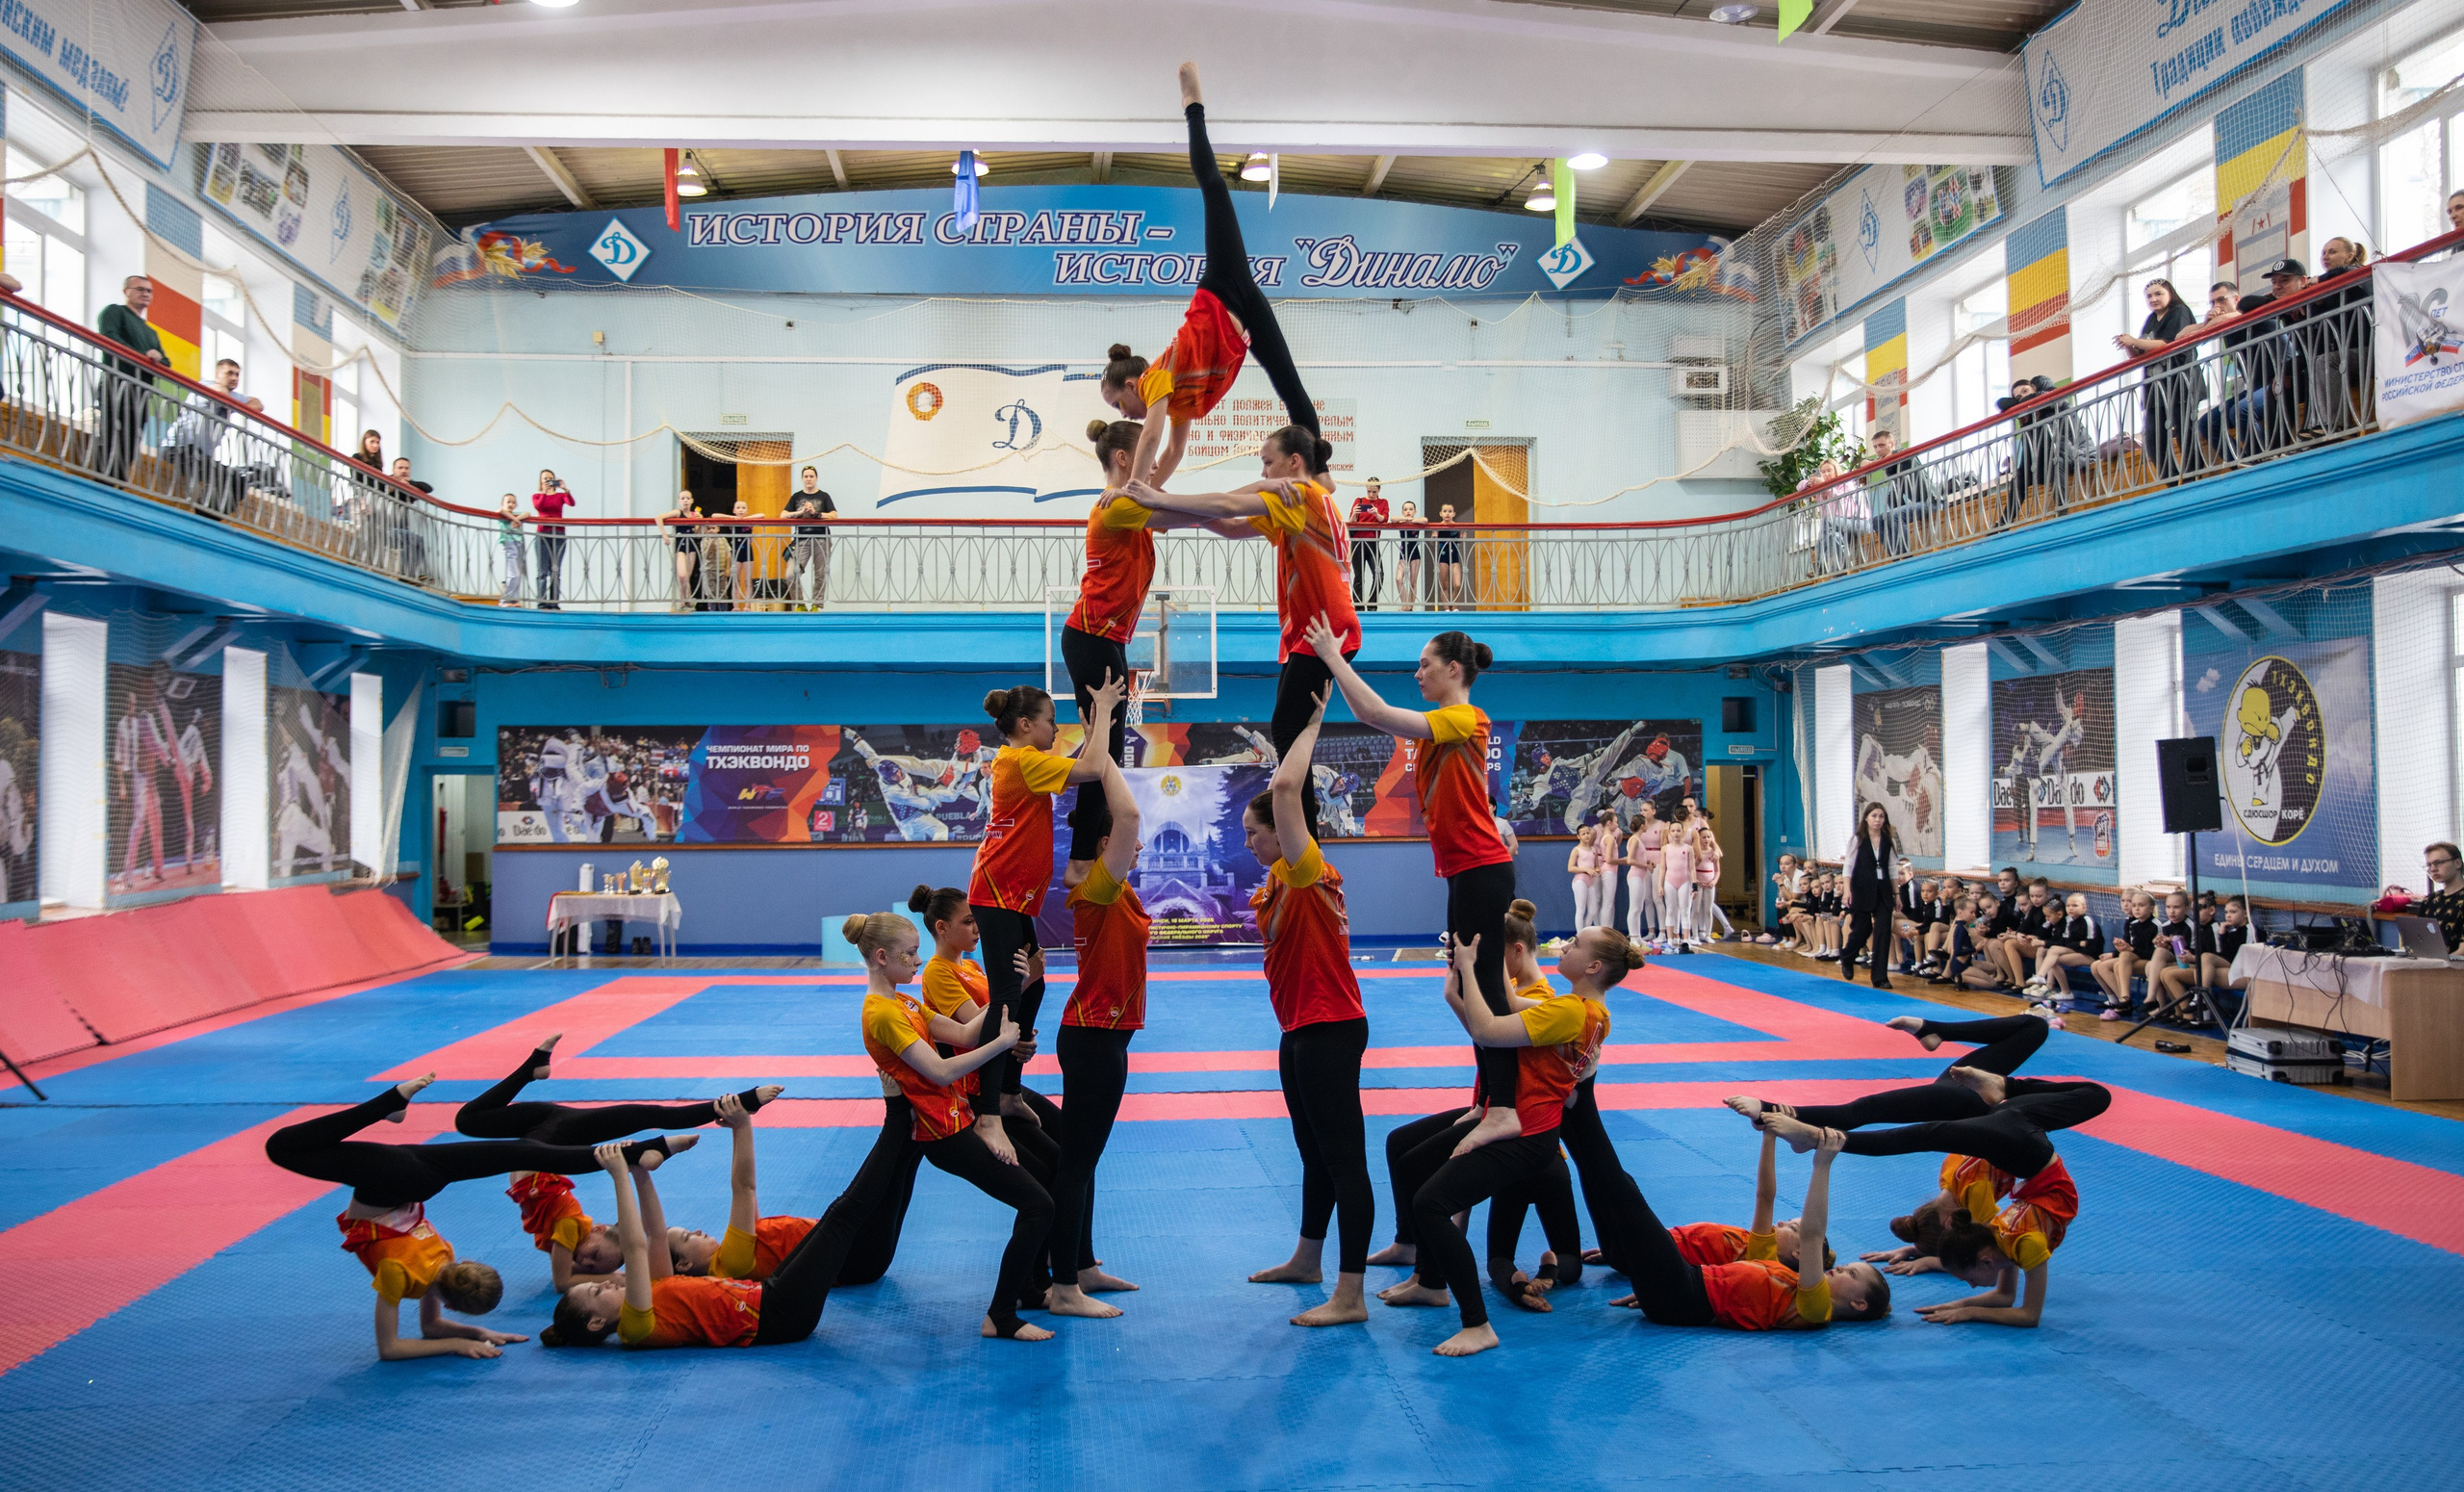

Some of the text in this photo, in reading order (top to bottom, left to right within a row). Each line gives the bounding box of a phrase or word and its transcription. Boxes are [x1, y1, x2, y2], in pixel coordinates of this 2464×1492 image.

[687, 211, 927, 245] ИСТОРИЯ
[934, 211, 1143, 245] СТРАНЫ
[1055, 252, 1287, 287] ИСТОРЯ
[706, 744, 810, 754] ЧЕМПИОНАТ МИРА ПО
[706, 755, 810, 772] ТХЭКВОНДО
[1993, 775, 2085, 807] Dae Dado
[2246, 855, 2290, 871] СЕРДЦЕМ
[2293, 858, 2299, 871] И
[2300, 859, 2339, 874] ДУХОМ
